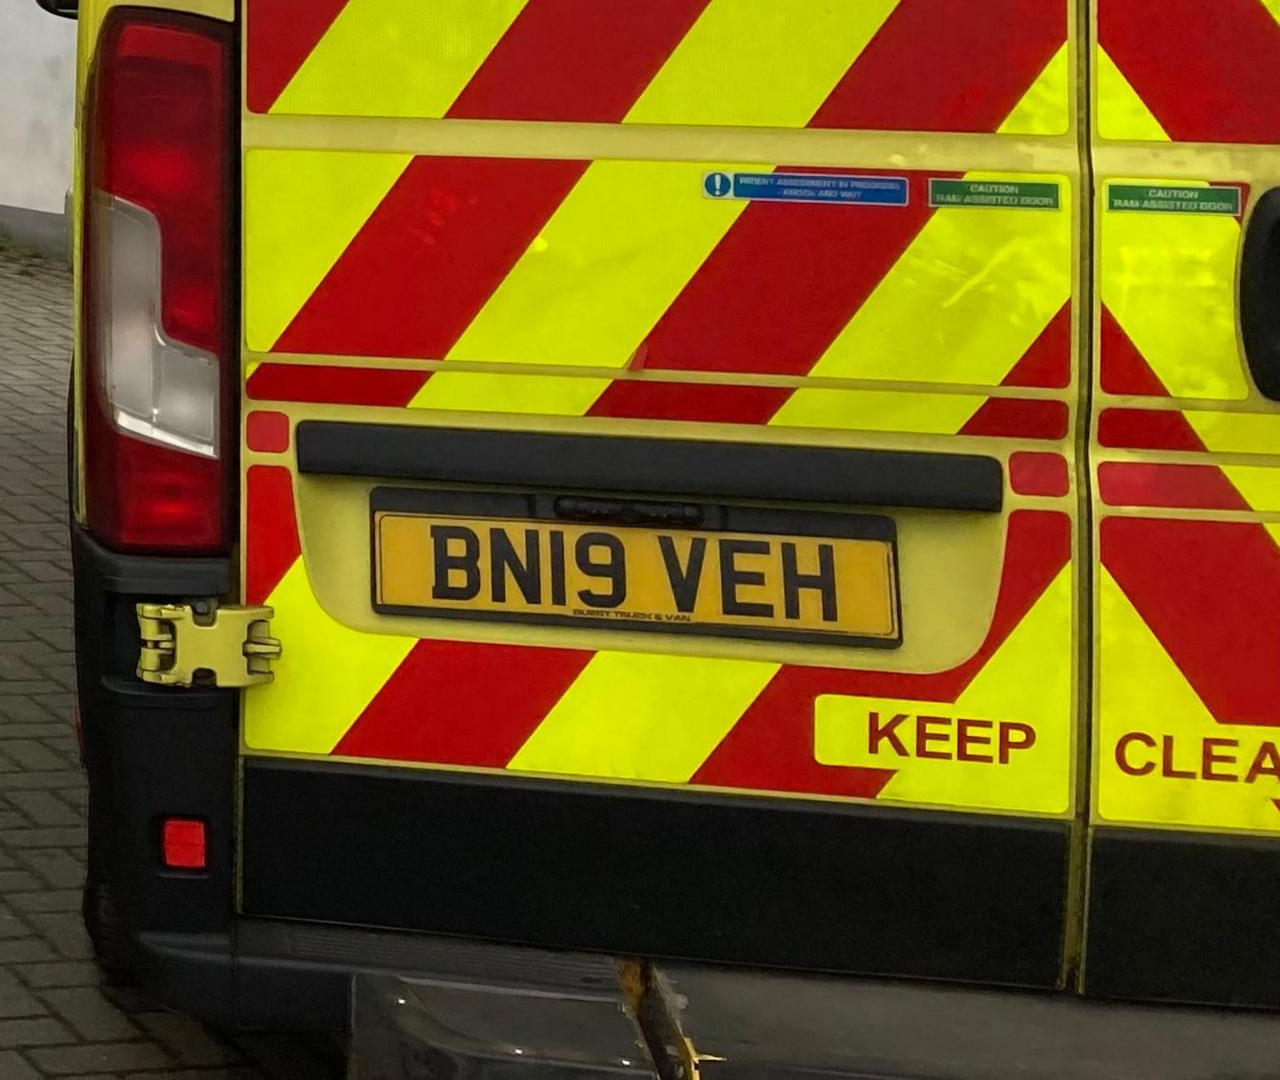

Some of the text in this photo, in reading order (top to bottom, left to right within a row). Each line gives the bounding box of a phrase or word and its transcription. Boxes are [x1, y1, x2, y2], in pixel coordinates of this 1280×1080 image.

[970, 184, 1019, 193] CAUTION
[1148, 189, 1198, 198] CAUTION
[1142, 200, 1197, 210] ASSISTED
[430, 524, 838, 622] BN19 VEH
[665, 613, 691, 622] VAN
[868, 712, 1280, 784] KEEP CLEA
